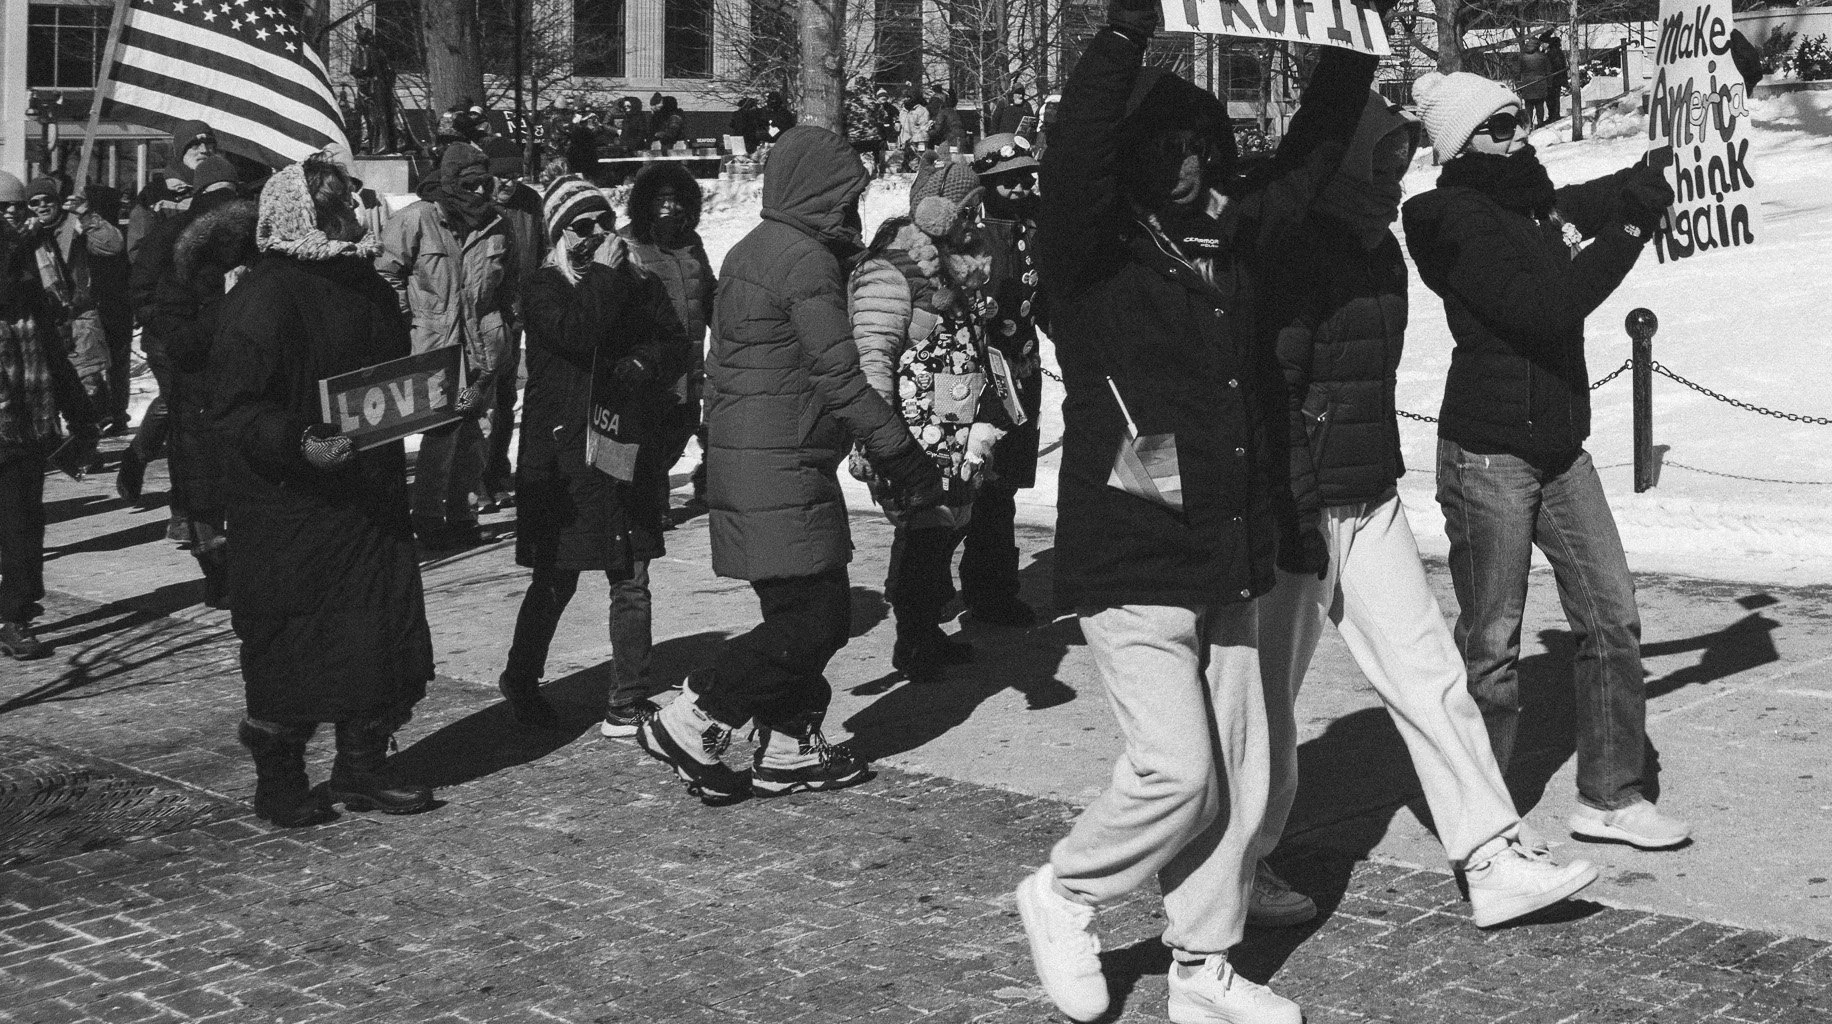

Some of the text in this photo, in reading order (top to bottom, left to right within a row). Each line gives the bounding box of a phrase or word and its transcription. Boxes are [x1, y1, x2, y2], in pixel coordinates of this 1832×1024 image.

[1674, 138, 1755, 204] hink
[337, 368, 448, 433] LOVE
[593, 404, 620, 435] USA
